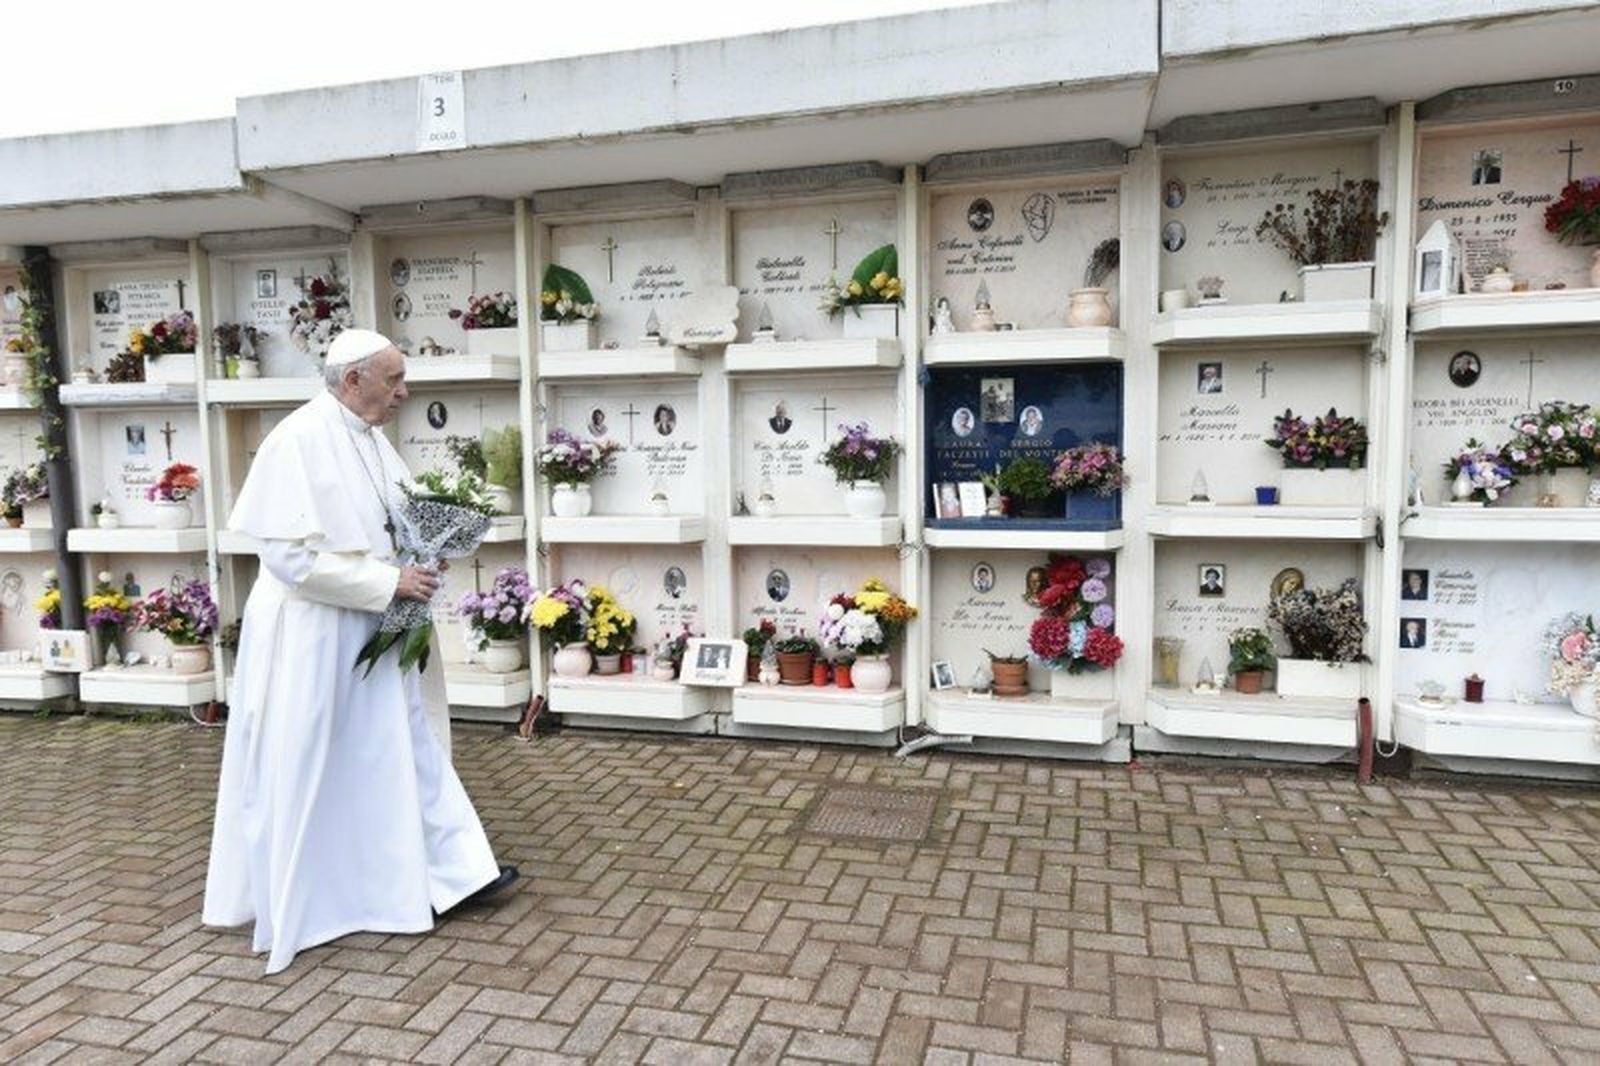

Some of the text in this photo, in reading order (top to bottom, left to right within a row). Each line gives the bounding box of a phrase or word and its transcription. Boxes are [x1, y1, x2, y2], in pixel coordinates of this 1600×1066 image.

[1558, 80, 1573, 90] 10
[433, 97, 445, 117] 3
[1418, 190, 1551, 211] Domenico Cerqua
[1011, 439, 1053, 447] SERGIO
